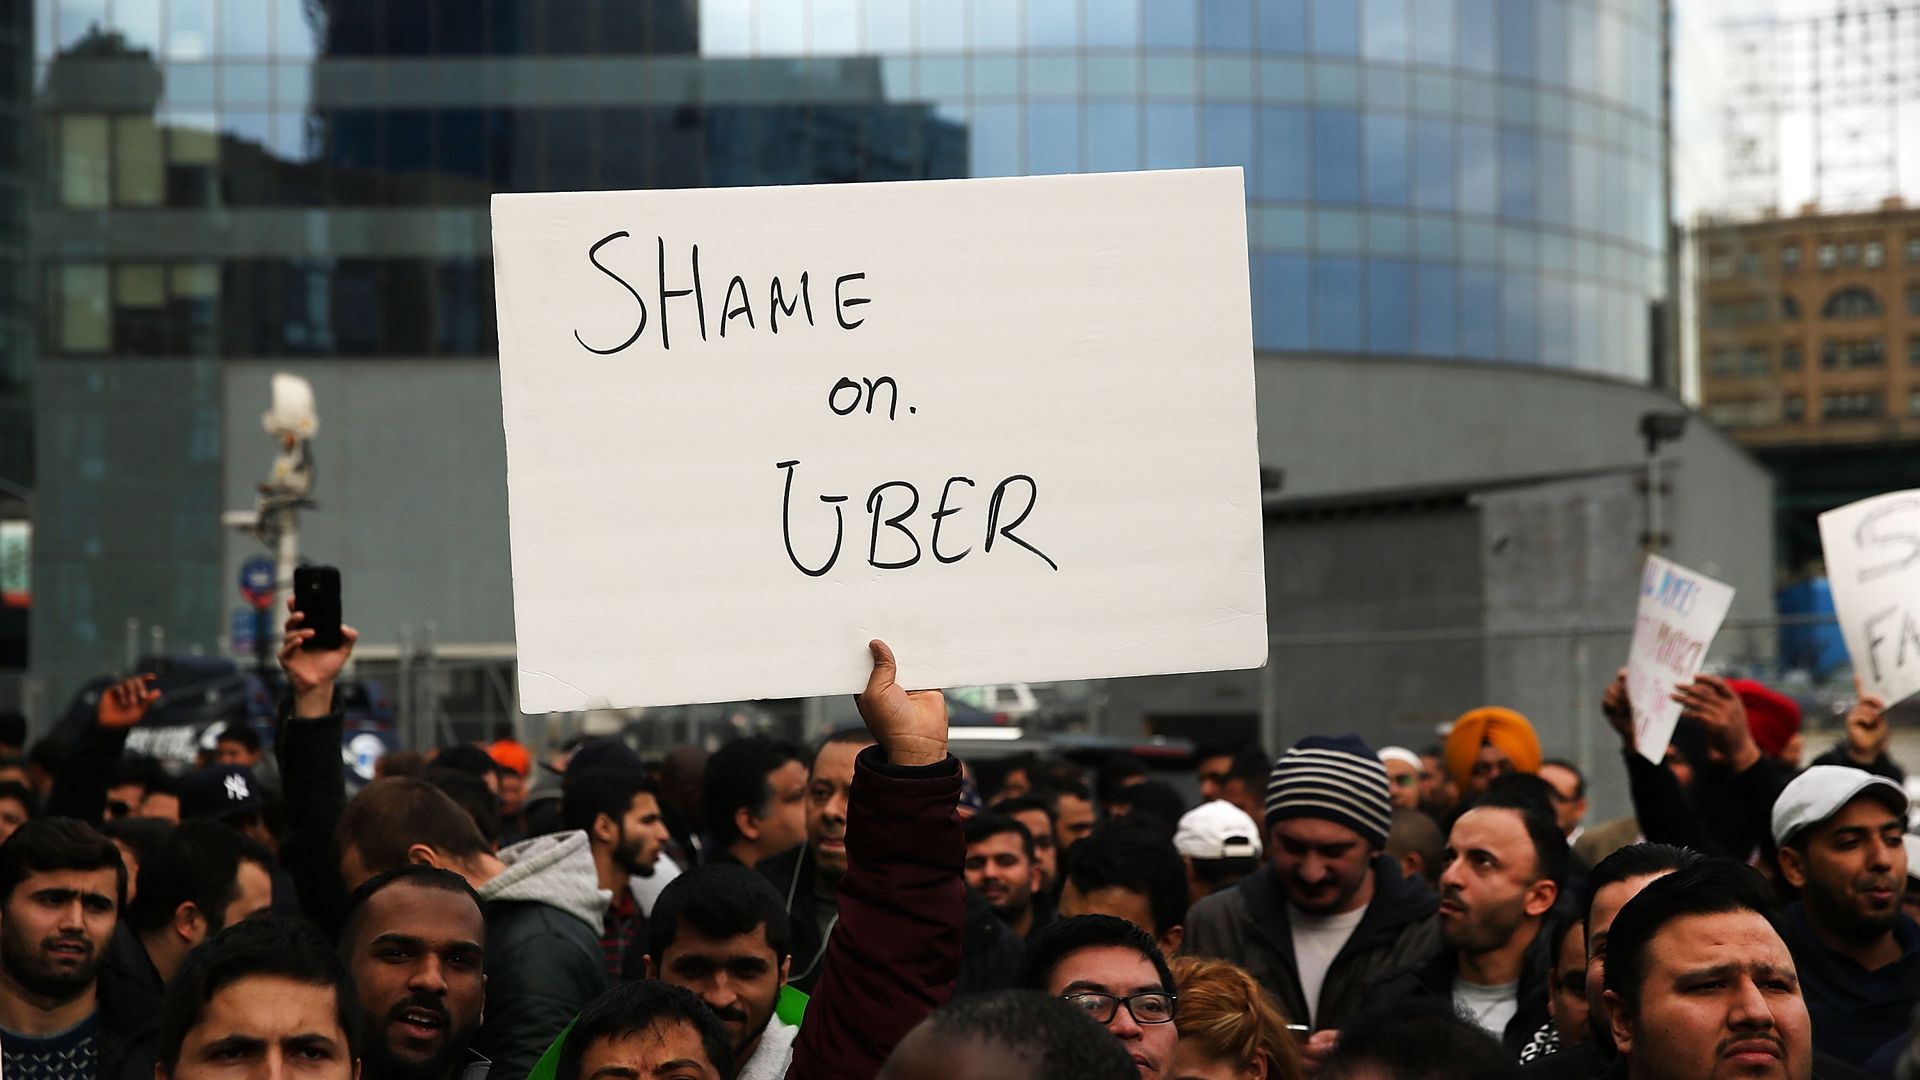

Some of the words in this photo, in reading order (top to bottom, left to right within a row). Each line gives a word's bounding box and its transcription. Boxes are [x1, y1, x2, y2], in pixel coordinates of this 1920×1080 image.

[574, 230, 872, 355] SHAME
[828, 375, 917, 421] on.
[775, 459, 1058, 577] UBER
